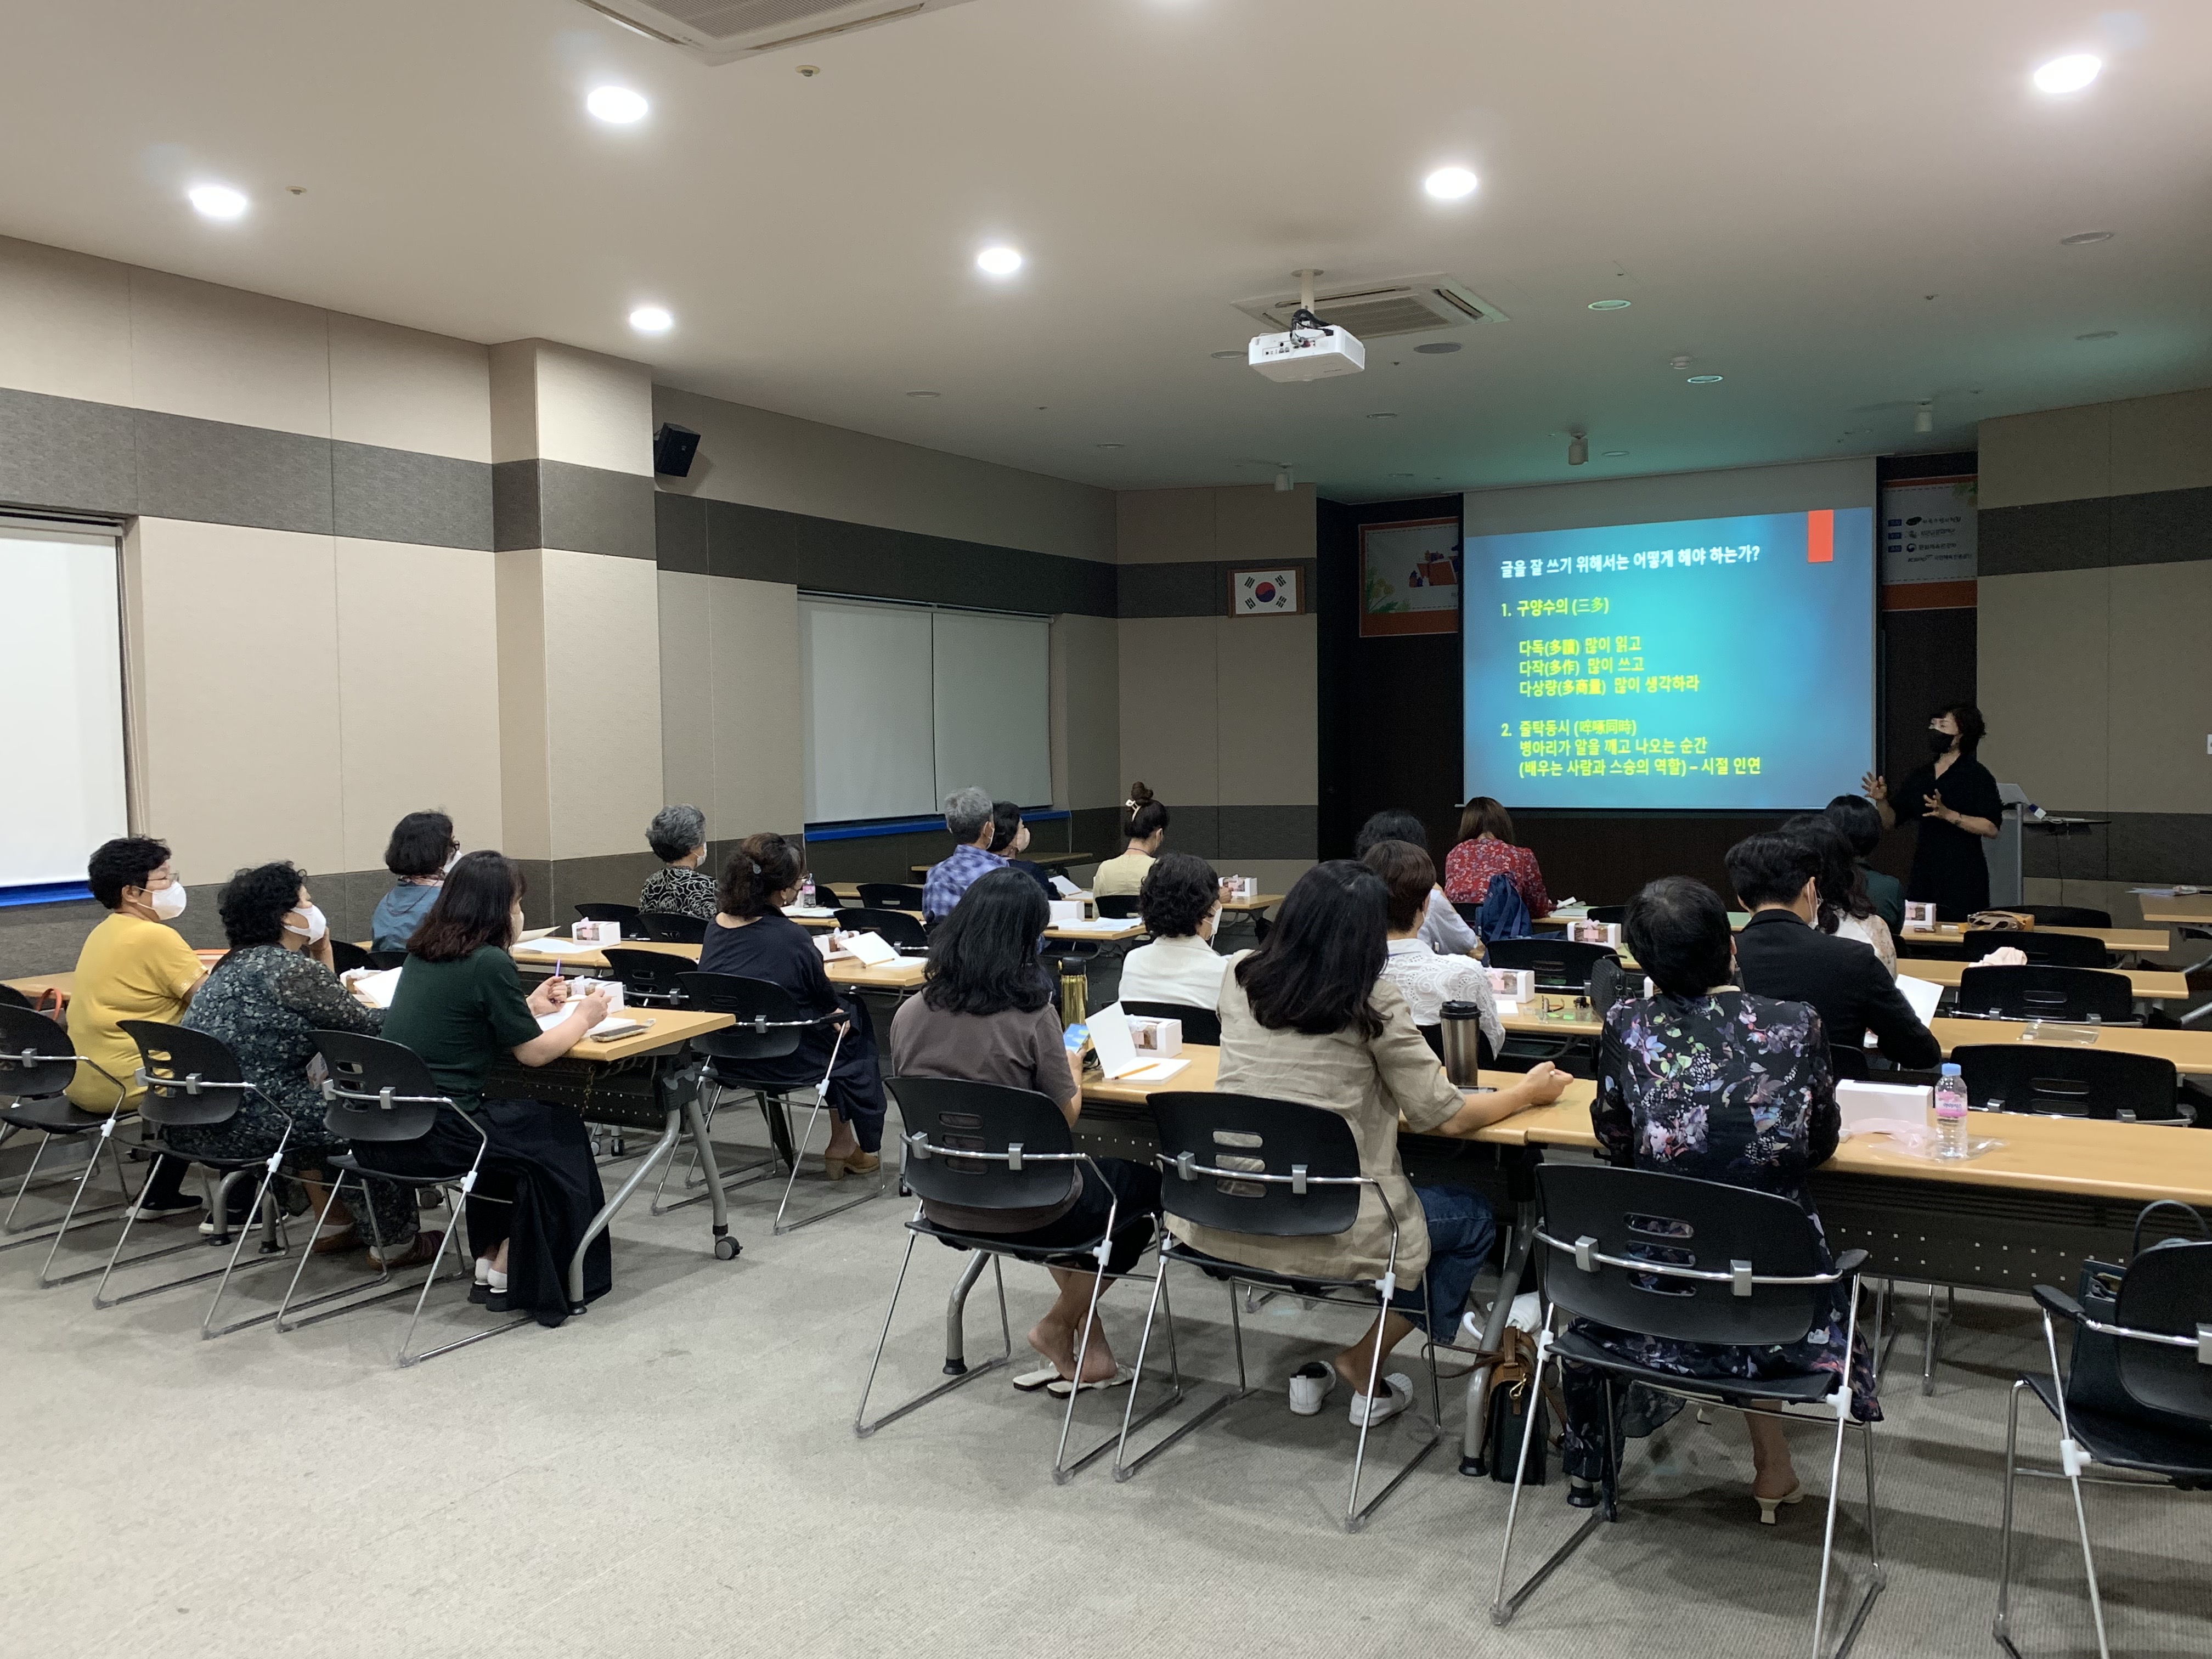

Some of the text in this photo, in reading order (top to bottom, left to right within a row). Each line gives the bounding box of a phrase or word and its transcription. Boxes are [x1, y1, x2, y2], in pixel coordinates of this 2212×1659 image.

[1501, 544, 1760, 578] 글을 잘 쓰기 위해서는 어떻게 해야 하는가?
[1502, 597, 1609, 617] 1. 구양수의 (三多)
[1585, 636, 1610, 654] 많이
[1615, 636, 1641, 652] 읽고
[1588, 657, 1613, 674] 많이
[1617, 657, 1644, 671] 쓰고
[1615, 676, 1640, 693] 많이
[1645, 674, 1700, 693] 생각하라
[1501, 723, 1512, 737] 2.
[1519, 719, 1569, 737] 줄탁동시
[1520, 736, 1707, 757] 병아리가 알을 깨고 나오는 순간
[1519, 760, 1562, 778] (배우는
[1567, 759, 1606, 777] 사람과
[1610, 758, 1649, 776] 스승의
[1734, 757, 1760, 775] 인연
